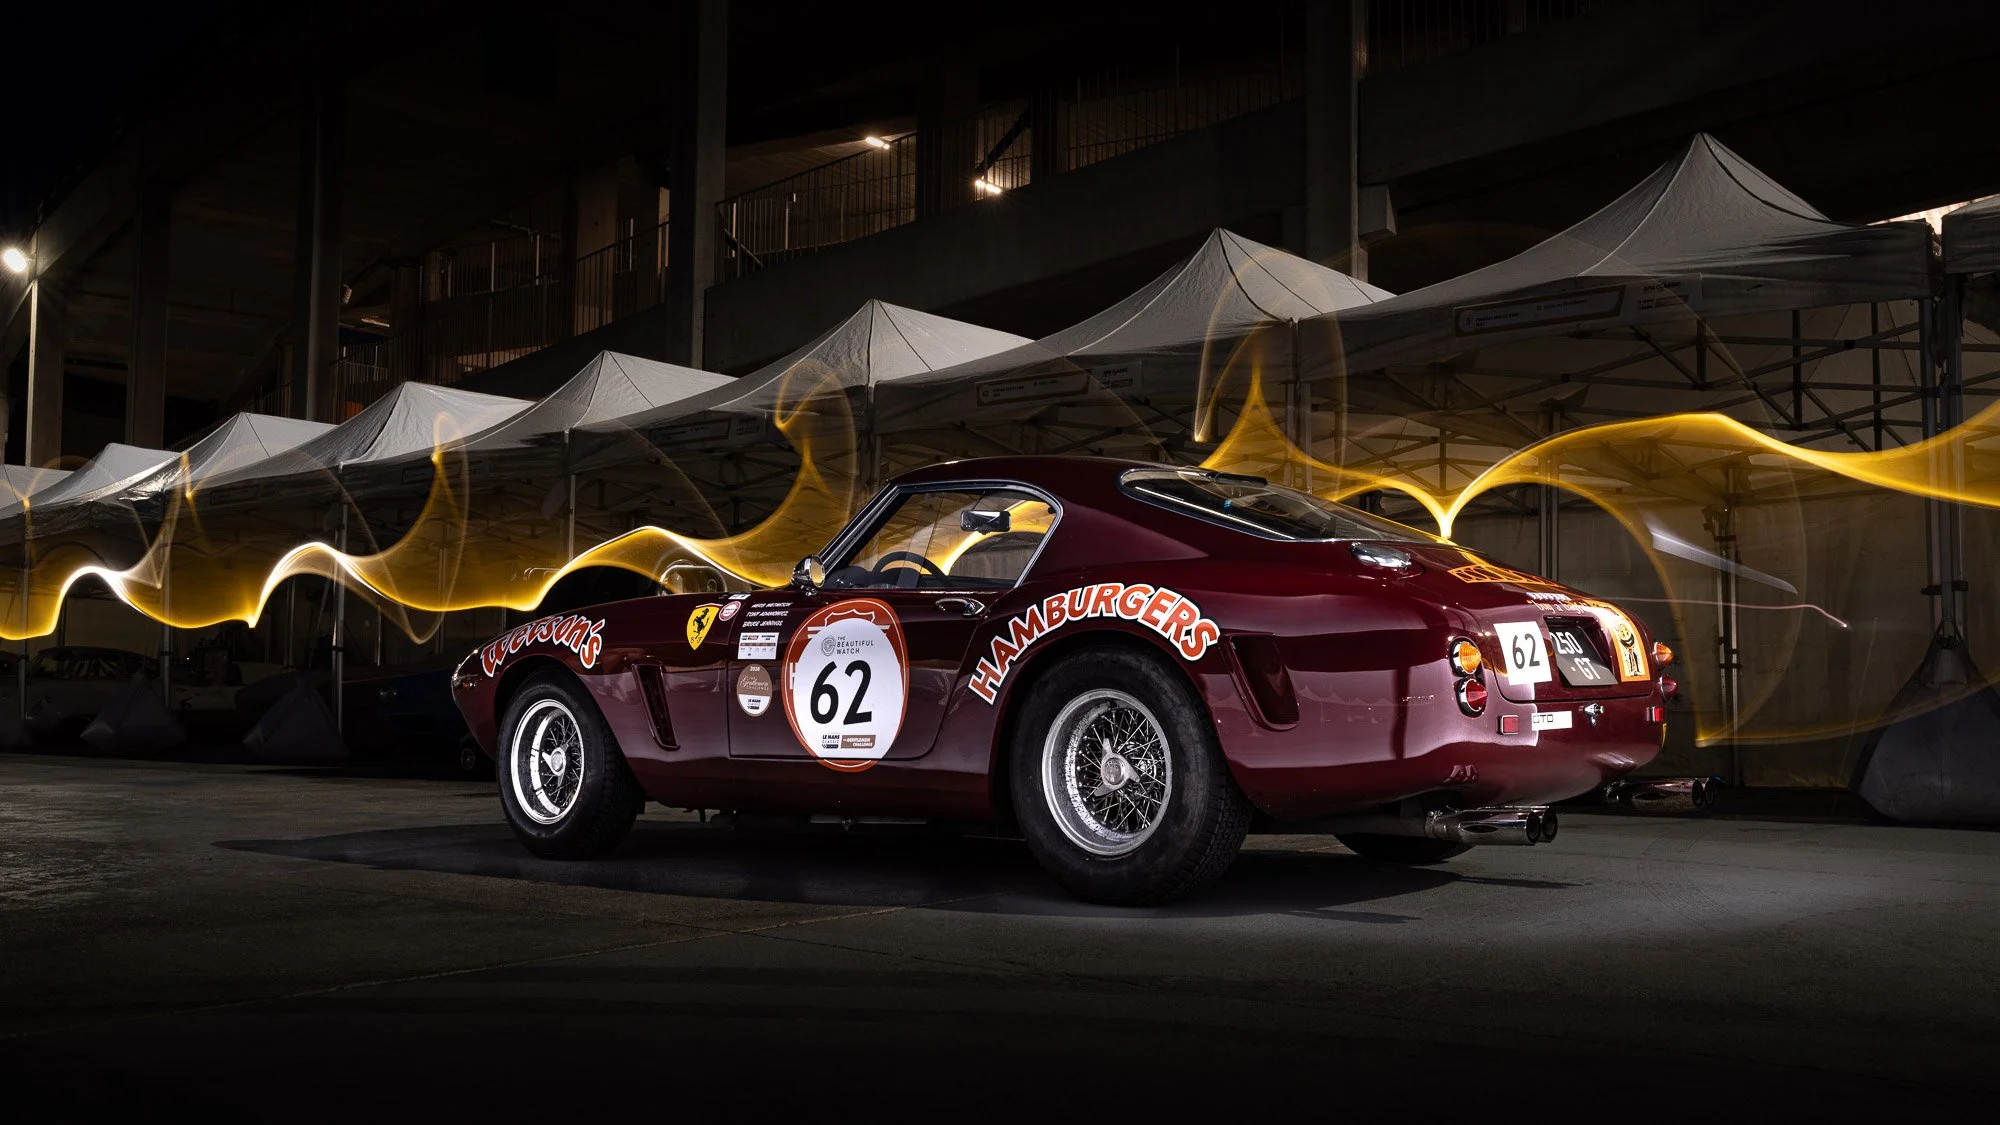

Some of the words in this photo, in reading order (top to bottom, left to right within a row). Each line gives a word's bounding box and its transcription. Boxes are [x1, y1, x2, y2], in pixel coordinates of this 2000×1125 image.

[480, 614, 606, 677] Wetson's
[836, 640, 875, 648] BEAUTIFUL
[968, 582, 1221, 705] HAMBURGERS
[1512, 633, 1540, 669] 62
[1549, 631, 1583, 655] 250
[810, 659, 873, 725] 62
